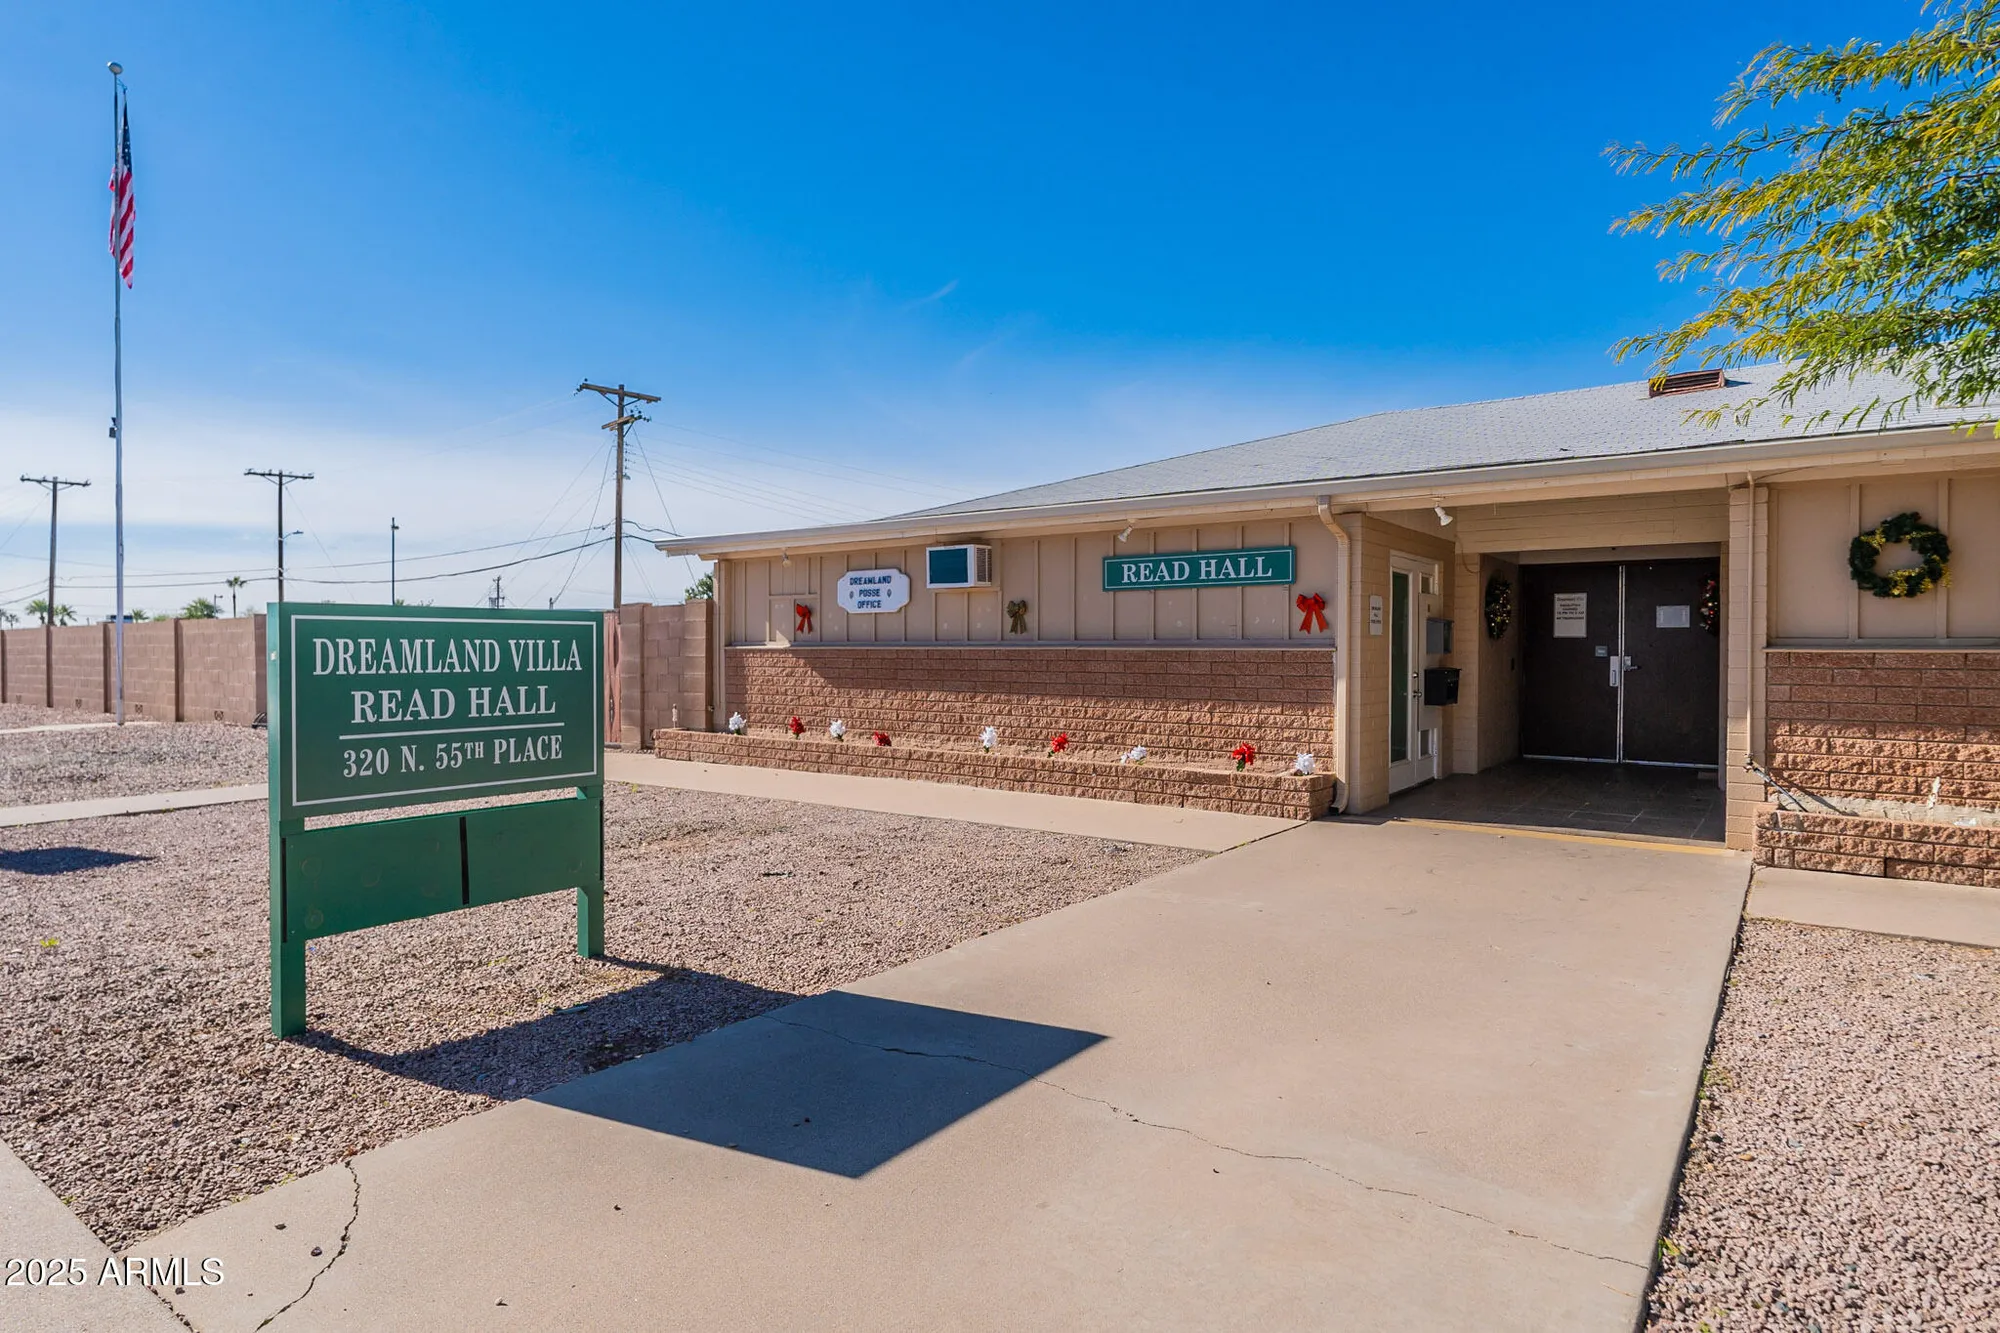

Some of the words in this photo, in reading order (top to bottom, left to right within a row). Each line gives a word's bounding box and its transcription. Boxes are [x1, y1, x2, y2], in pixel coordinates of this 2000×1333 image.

[849, 576, 892, 586] DREAMLAND
[1121, 561, 1190, 584] READ
[1199, 556, 1272, 579] HALL
[857, 600, 882, 609] OFFICE
[858, 589, 881, 598] POSSE
[313, 638, 500, 676] DREAMLAND
[508, 639, 582, 673] VILLA
[351, 688, 456, 724] READ
[468, 685, 556, 718] HALL
[343, 747, 390, 778] 320
[400, 745, 425, 773] N.
[435, 741, 485, 770] 55TH
[493, 734, 563, 764] PLACE
